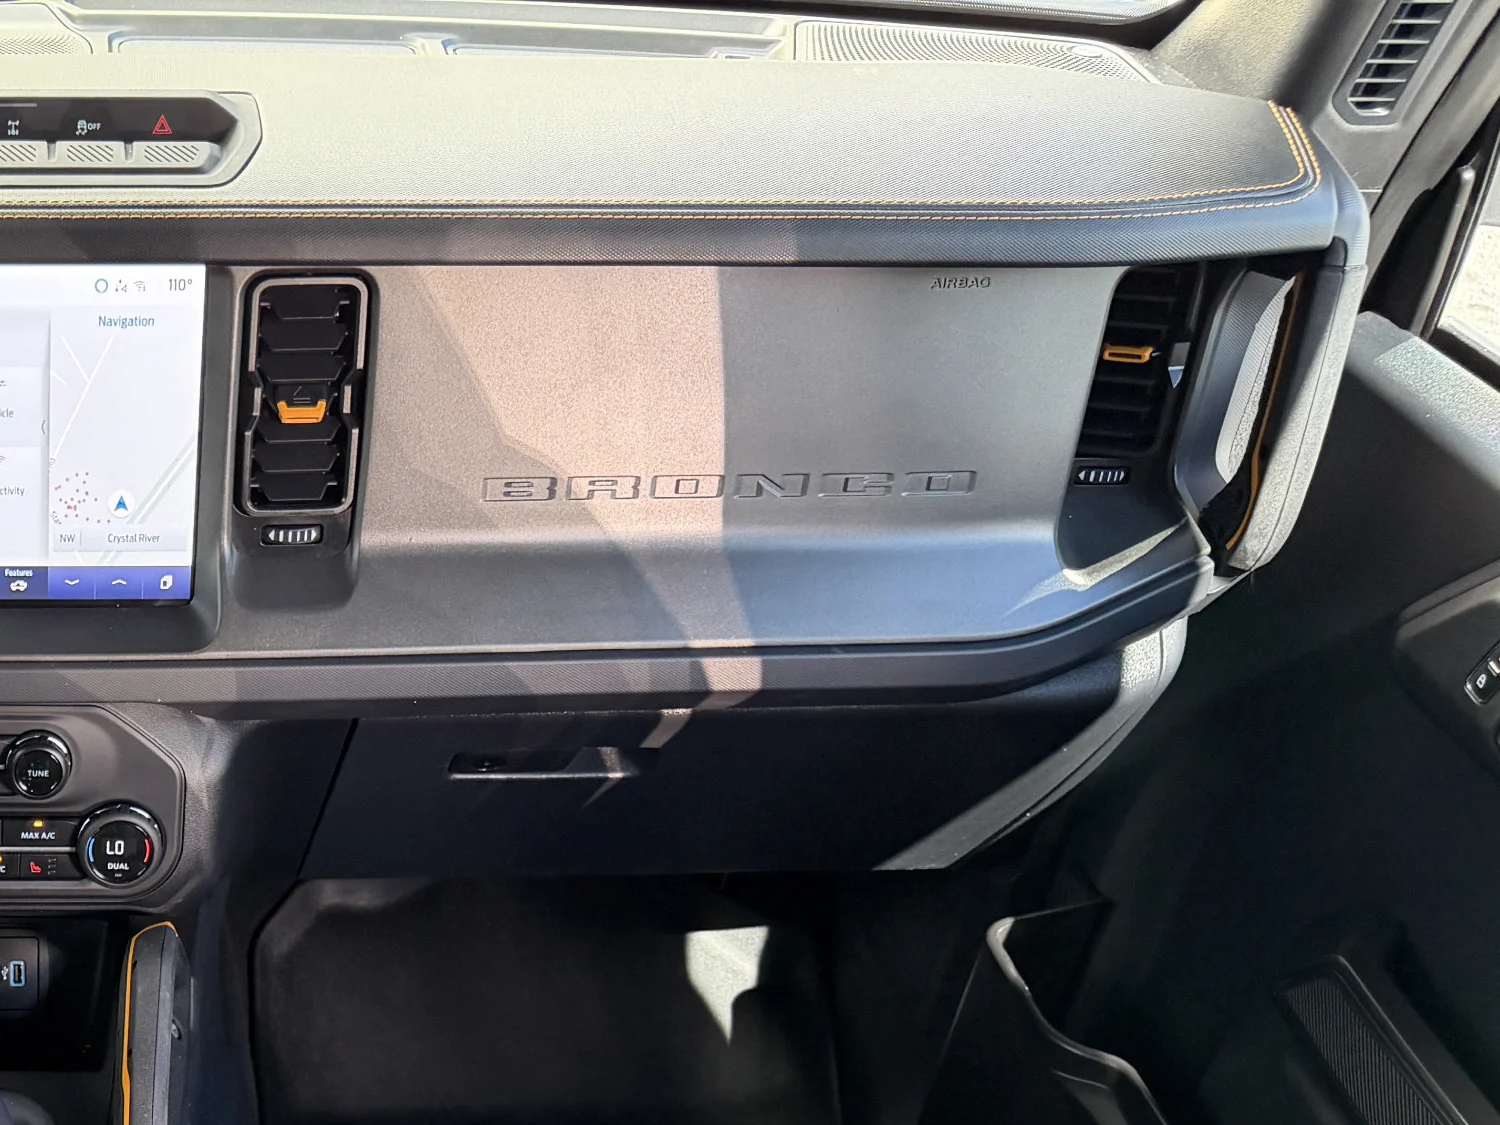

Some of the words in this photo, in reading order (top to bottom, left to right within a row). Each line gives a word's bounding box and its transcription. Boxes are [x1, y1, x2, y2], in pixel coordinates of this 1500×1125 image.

[98, 315, 155, 329] Navigation
[483, 471, 977, 503] BRONCO
[59, 534, 76, 543] NW
[108, 533, 137, 545] Crystal
[139, 533, 160, 543] River
[4, 568, 34, 578] Features
[27, 769, 50, 778] TUNE
[20, 831, 40, 840] MAX
[40, 831, 56, 840] A/C
[105, 840, 125, 855] LO
[107, 862, 130, 870] DUAL
